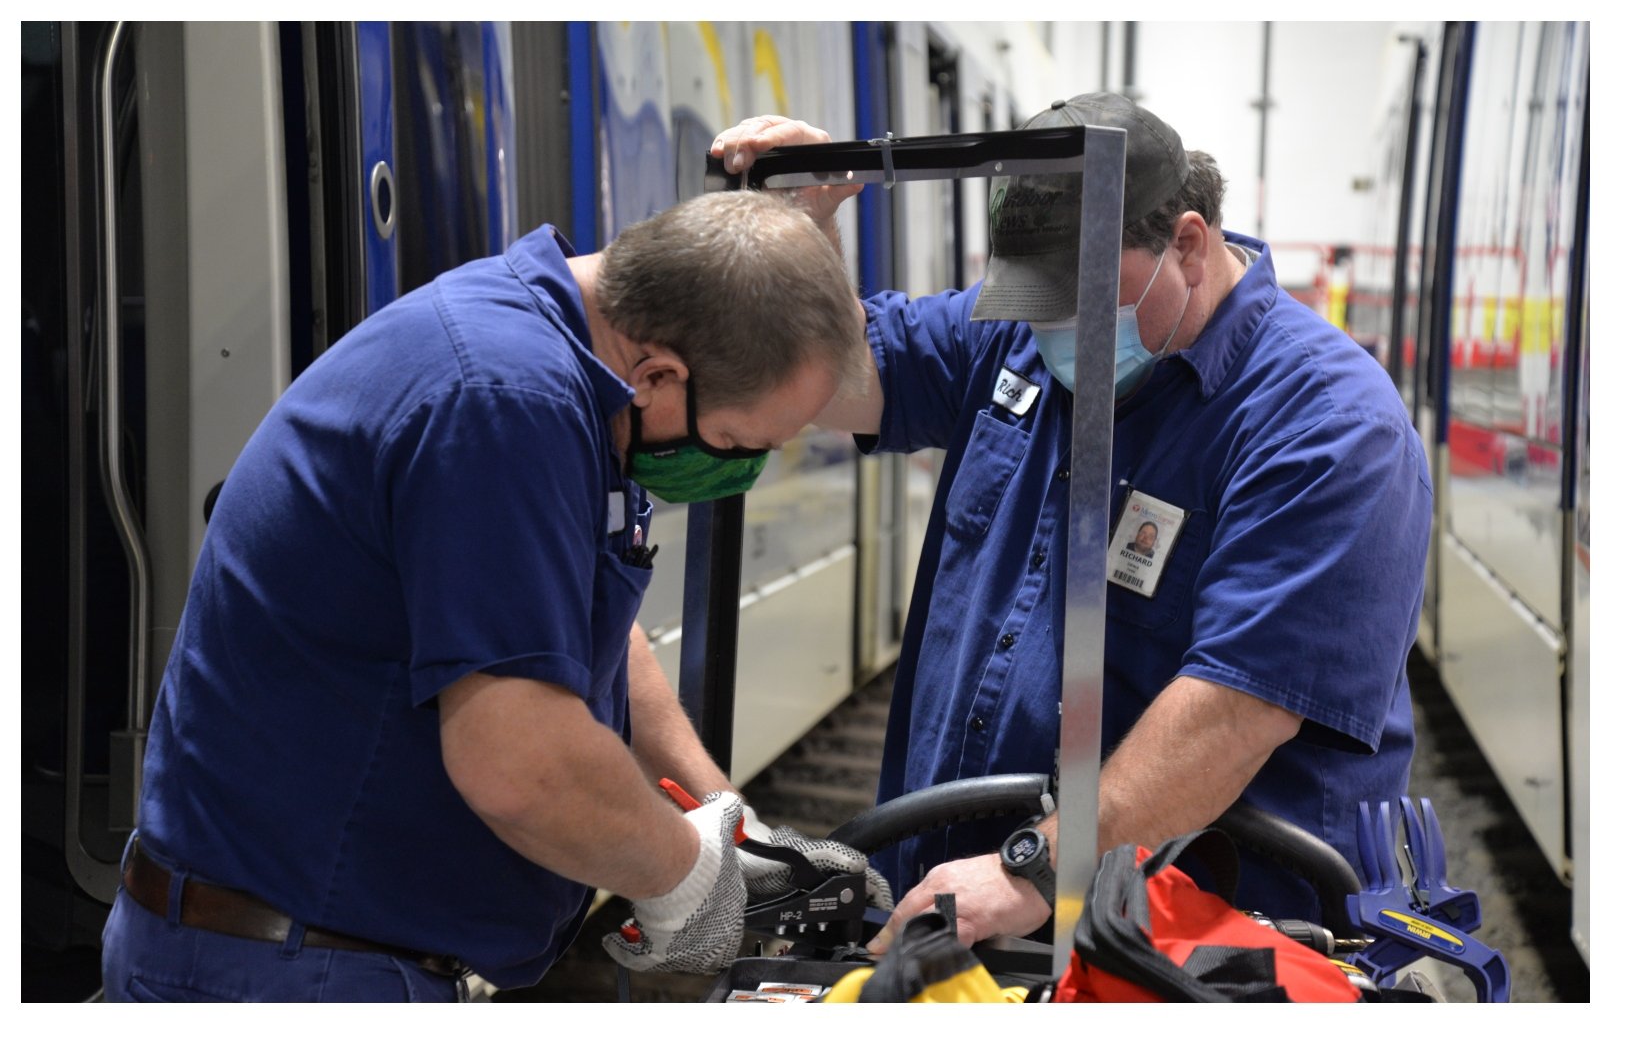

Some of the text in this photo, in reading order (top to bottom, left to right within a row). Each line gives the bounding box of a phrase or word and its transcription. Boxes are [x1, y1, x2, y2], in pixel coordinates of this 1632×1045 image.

[997, 378, 1022, 403] Rich
[1120, 549, 1153, 568] RICHARD
[779, 910, 803, 921] HP-2
[1406, 924, 1432, 940] IRWIN
